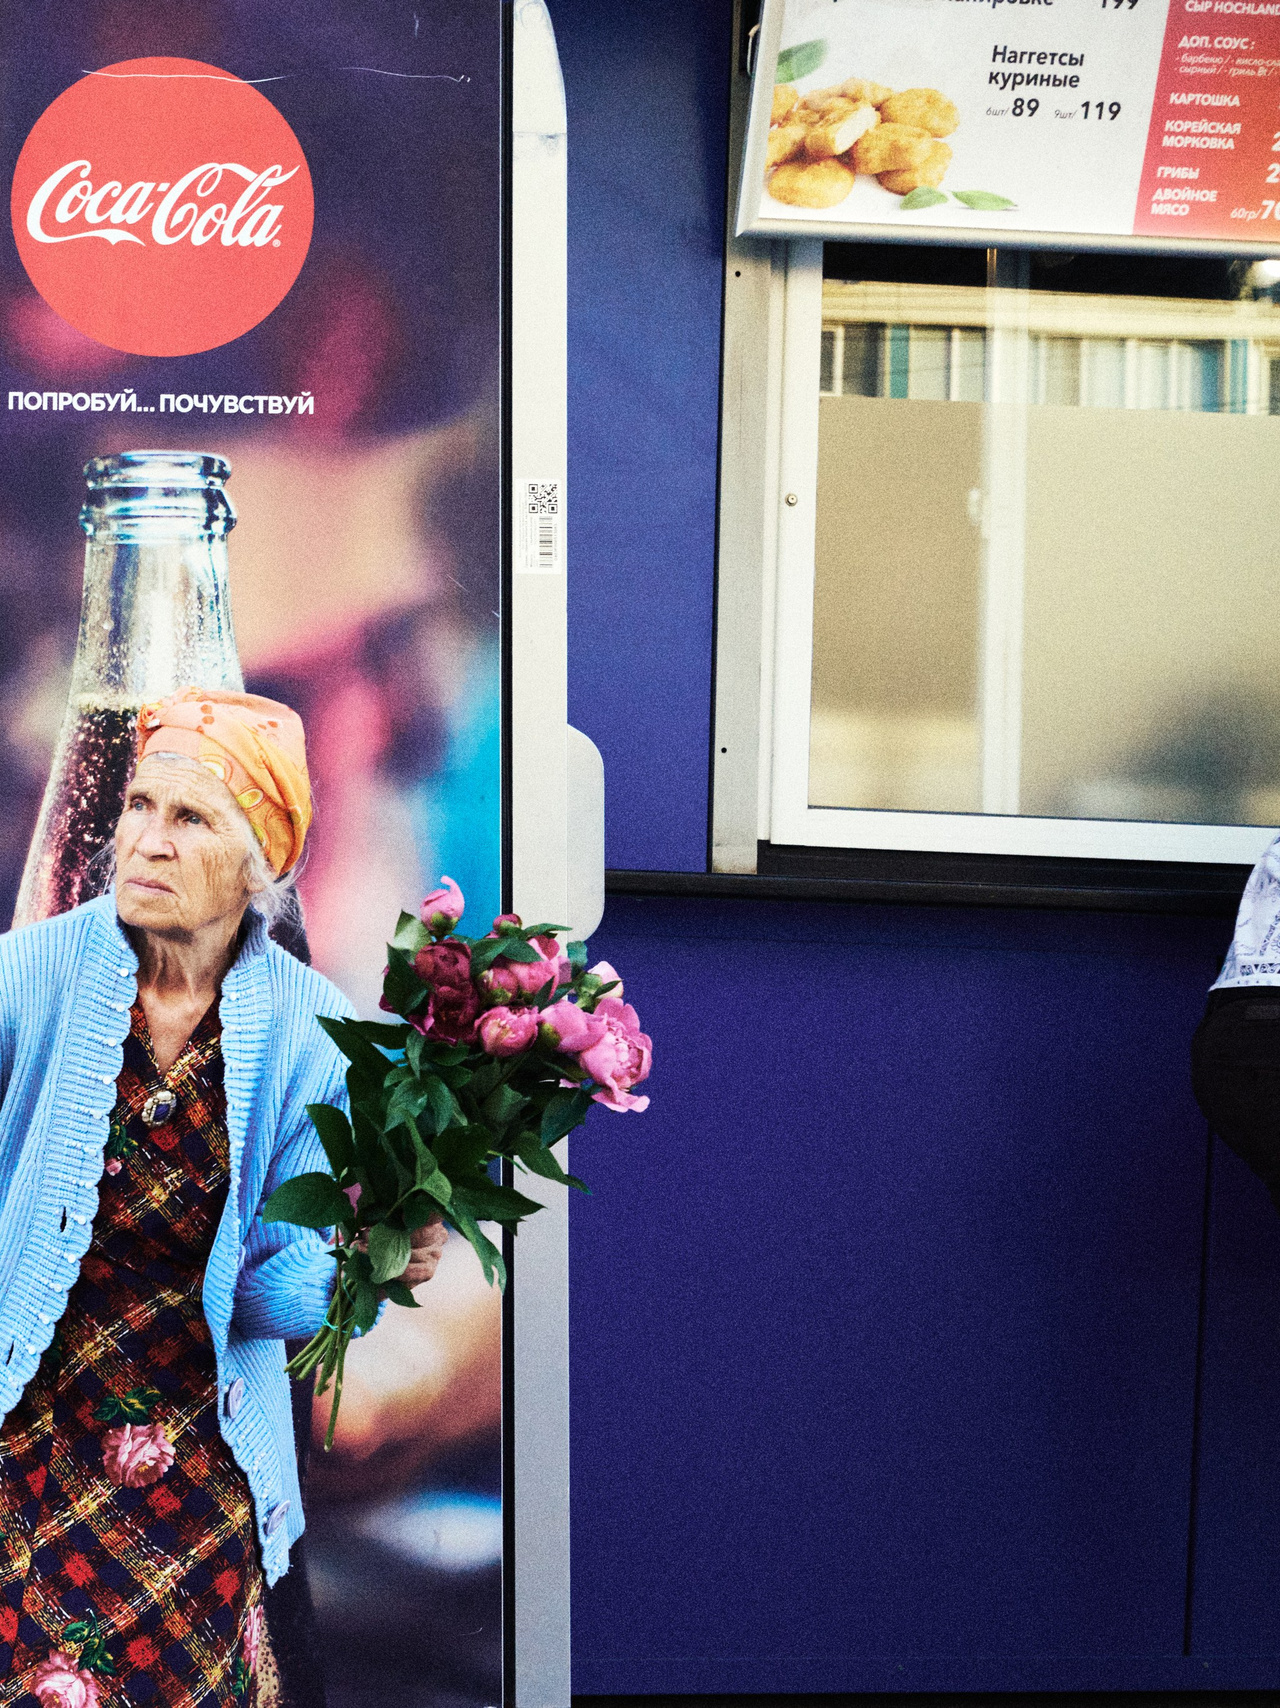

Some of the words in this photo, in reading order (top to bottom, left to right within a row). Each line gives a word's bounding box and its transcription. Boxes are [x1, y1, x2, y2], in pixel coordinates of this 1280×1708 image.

[1185, 0, 1212, 12] СЫР
[1178, 35, 1212, 48] ДОП.
[991, 45, 1085, 67] Наггетсы
[1181, 53, 1223, 65] барбекю
[1179, 65, 1217, 75] сырный
[988, 70, 1080, 91] куриные
[1169, 92, 1241, 107] КАРТОШКА
[1011, 97, 1040, 117] 89
[1081, 101, 1122, 121] 119
[1165, 119, 1242, 135] КОРЕЙСКАЯ
[1162, 135, 1235, 150] МОРКОВКА
[1156, 166, 1200, 179] ГРИБЫ
[1152, 187, 1218, 202] ДВОЙНОЕ
[1151, 203, 1190, 216] МЯСО
[8, 389, 155, 412] ПОПРОБУЙ...
[159, 391, 315, 415] ПОЧУВСТВУЙ
